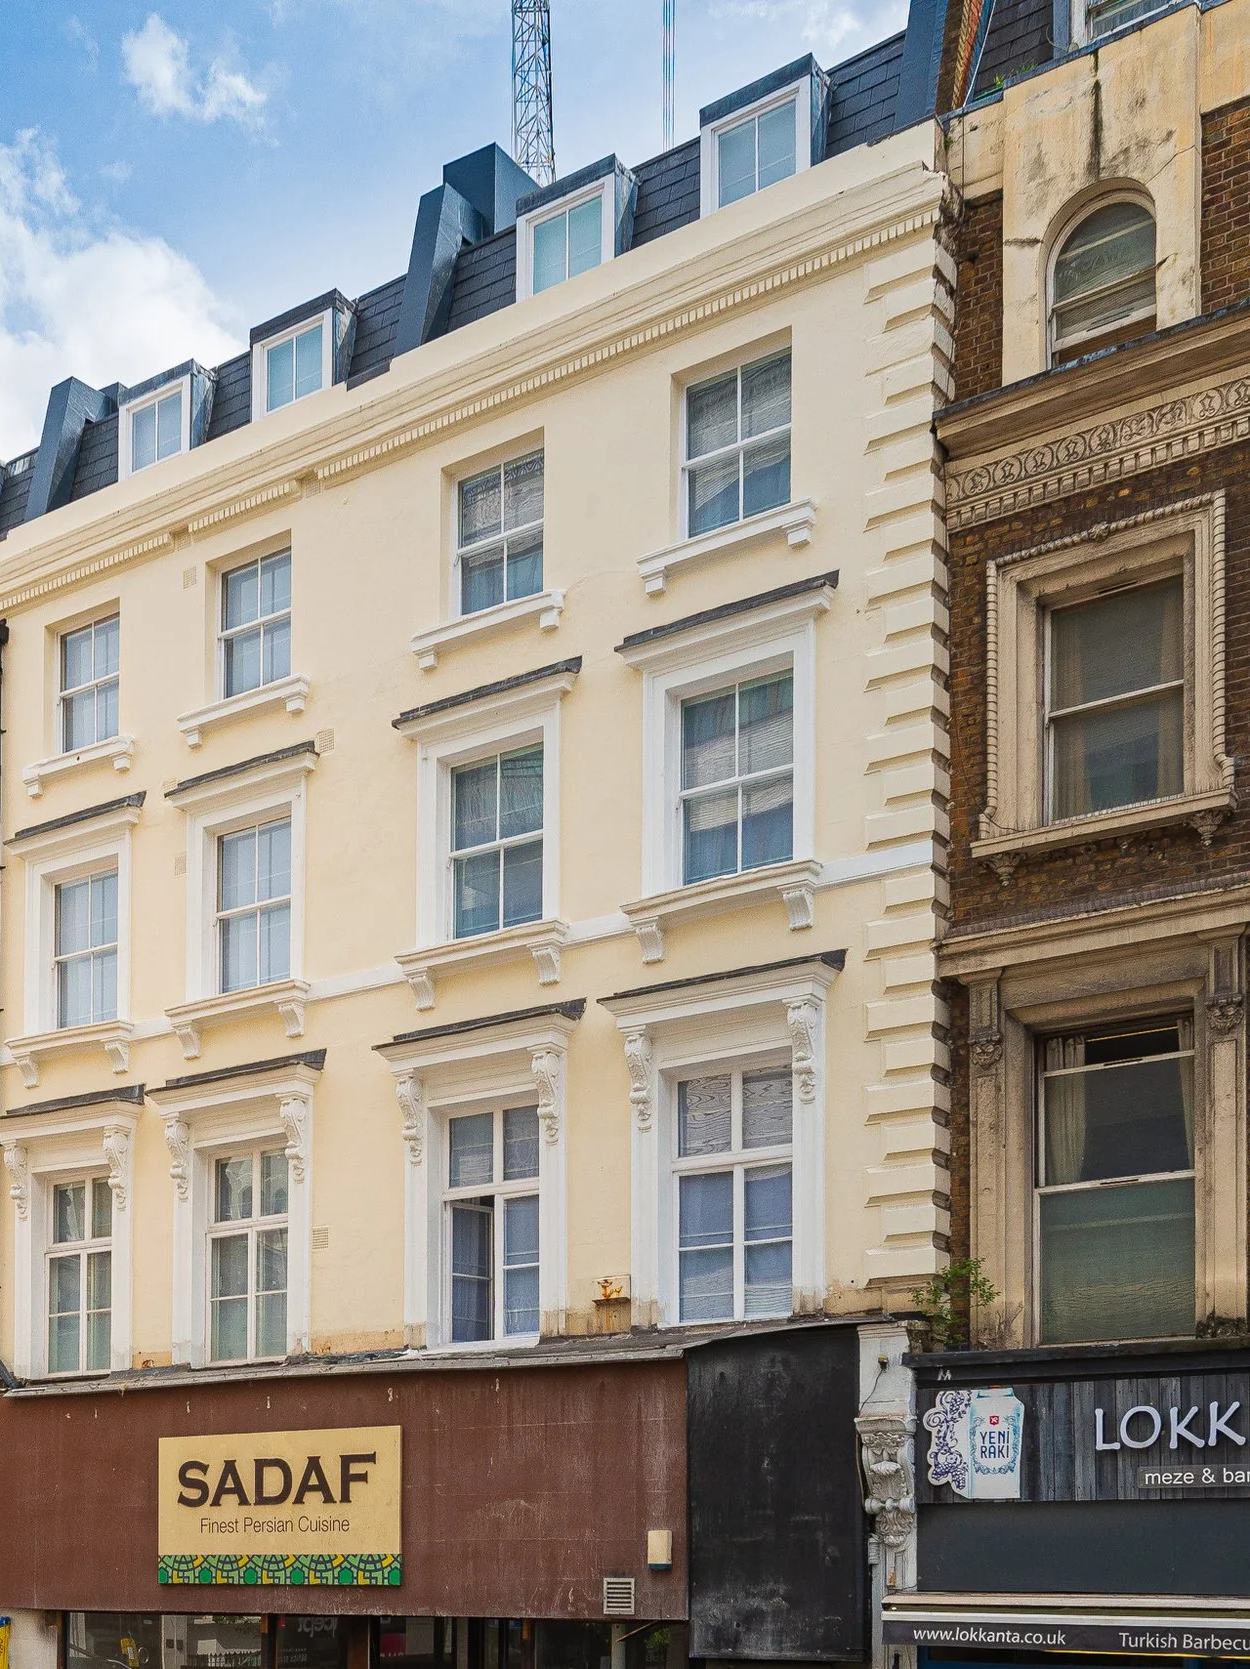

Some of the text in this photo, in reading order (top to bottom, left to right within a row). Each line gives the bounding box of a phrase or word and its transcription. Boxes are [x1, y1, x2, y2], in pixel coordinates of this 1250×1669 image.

[1095, 1401, 1246, 1450] LOKK
[980, 1445, 1010, 1459] RAKI
[177, 1451, 377, 1508] SADAF
[1145, 1471, 1195, 1485] meze
[1201, 1467, 1216, 1484] &
[200, 1515, 350, 1534] Finest Persian Cuisine
[913, 1627, 1066, 1645] www.lokkanta.co.uk
[1119, 1632, 1178, 1648] Turkish
